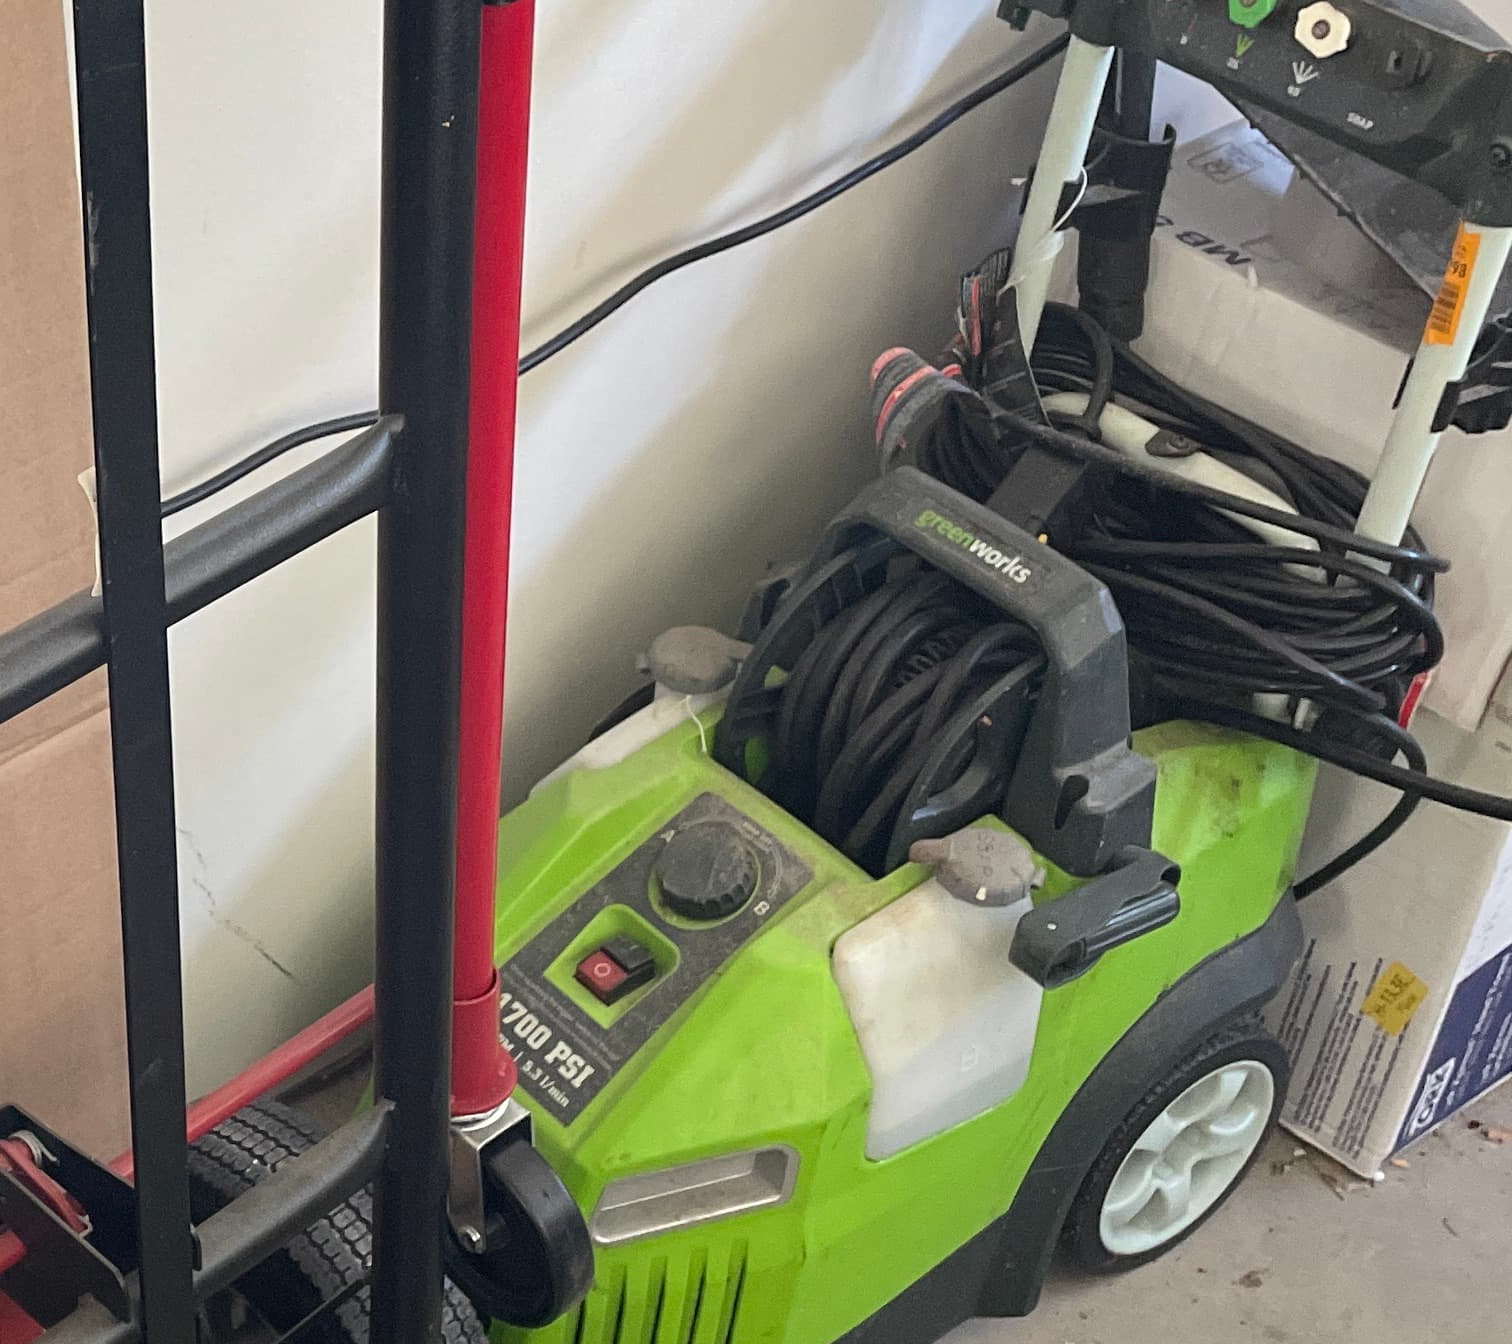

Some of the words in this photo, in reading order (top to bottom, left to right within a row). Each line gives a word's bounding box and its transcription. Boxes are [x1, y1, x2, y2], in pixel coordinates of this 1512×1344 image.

[914, 510, 1032, 584] greenworks
[753, 900, 770, 916] B
[544, 1040, 595, 1088] PSI
